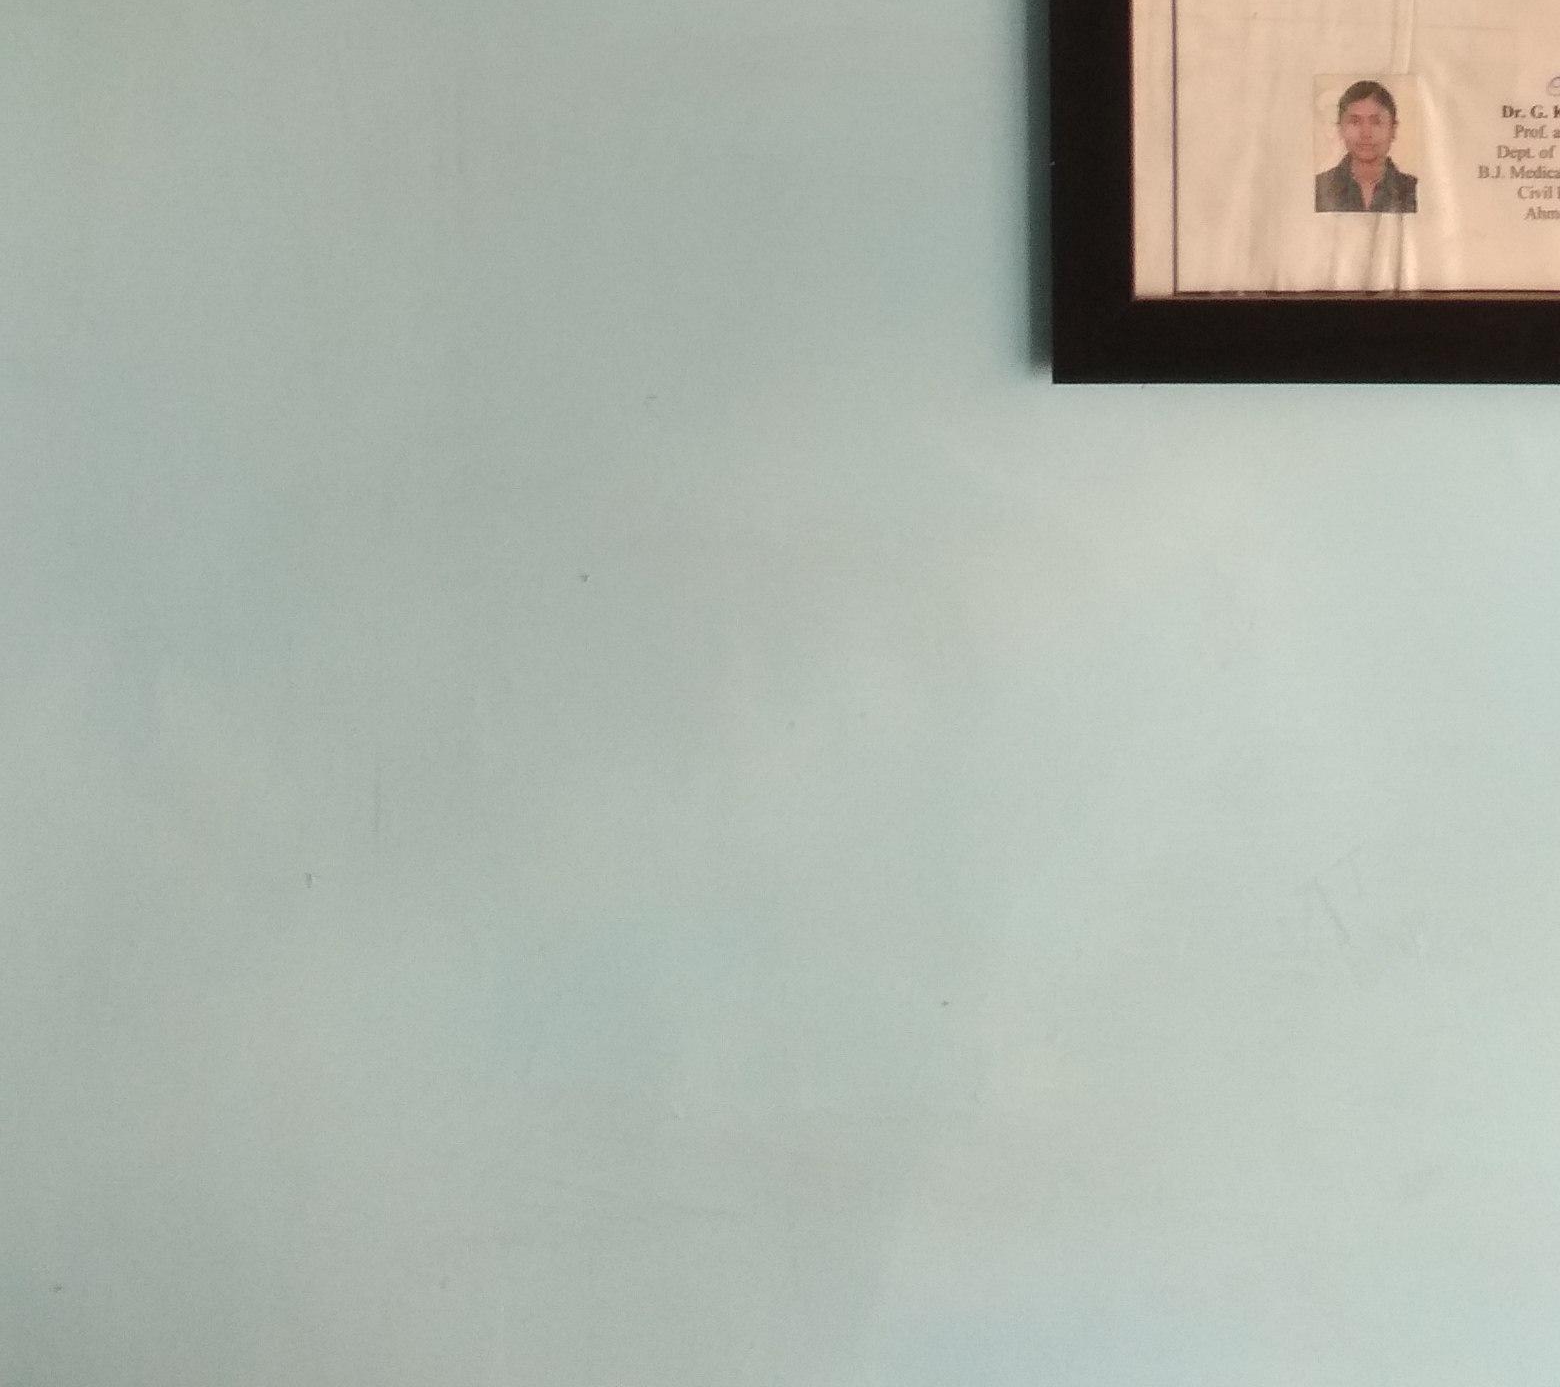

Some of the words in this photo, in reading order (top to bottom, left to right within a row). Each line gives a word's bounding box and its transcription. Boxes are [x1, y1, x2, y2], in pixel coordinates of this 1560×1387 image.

[1502, 105, 1527, 119] Dr.
[1530, 105, 1549, 119] G.
[1517, 187, 1553, 201] Civil
